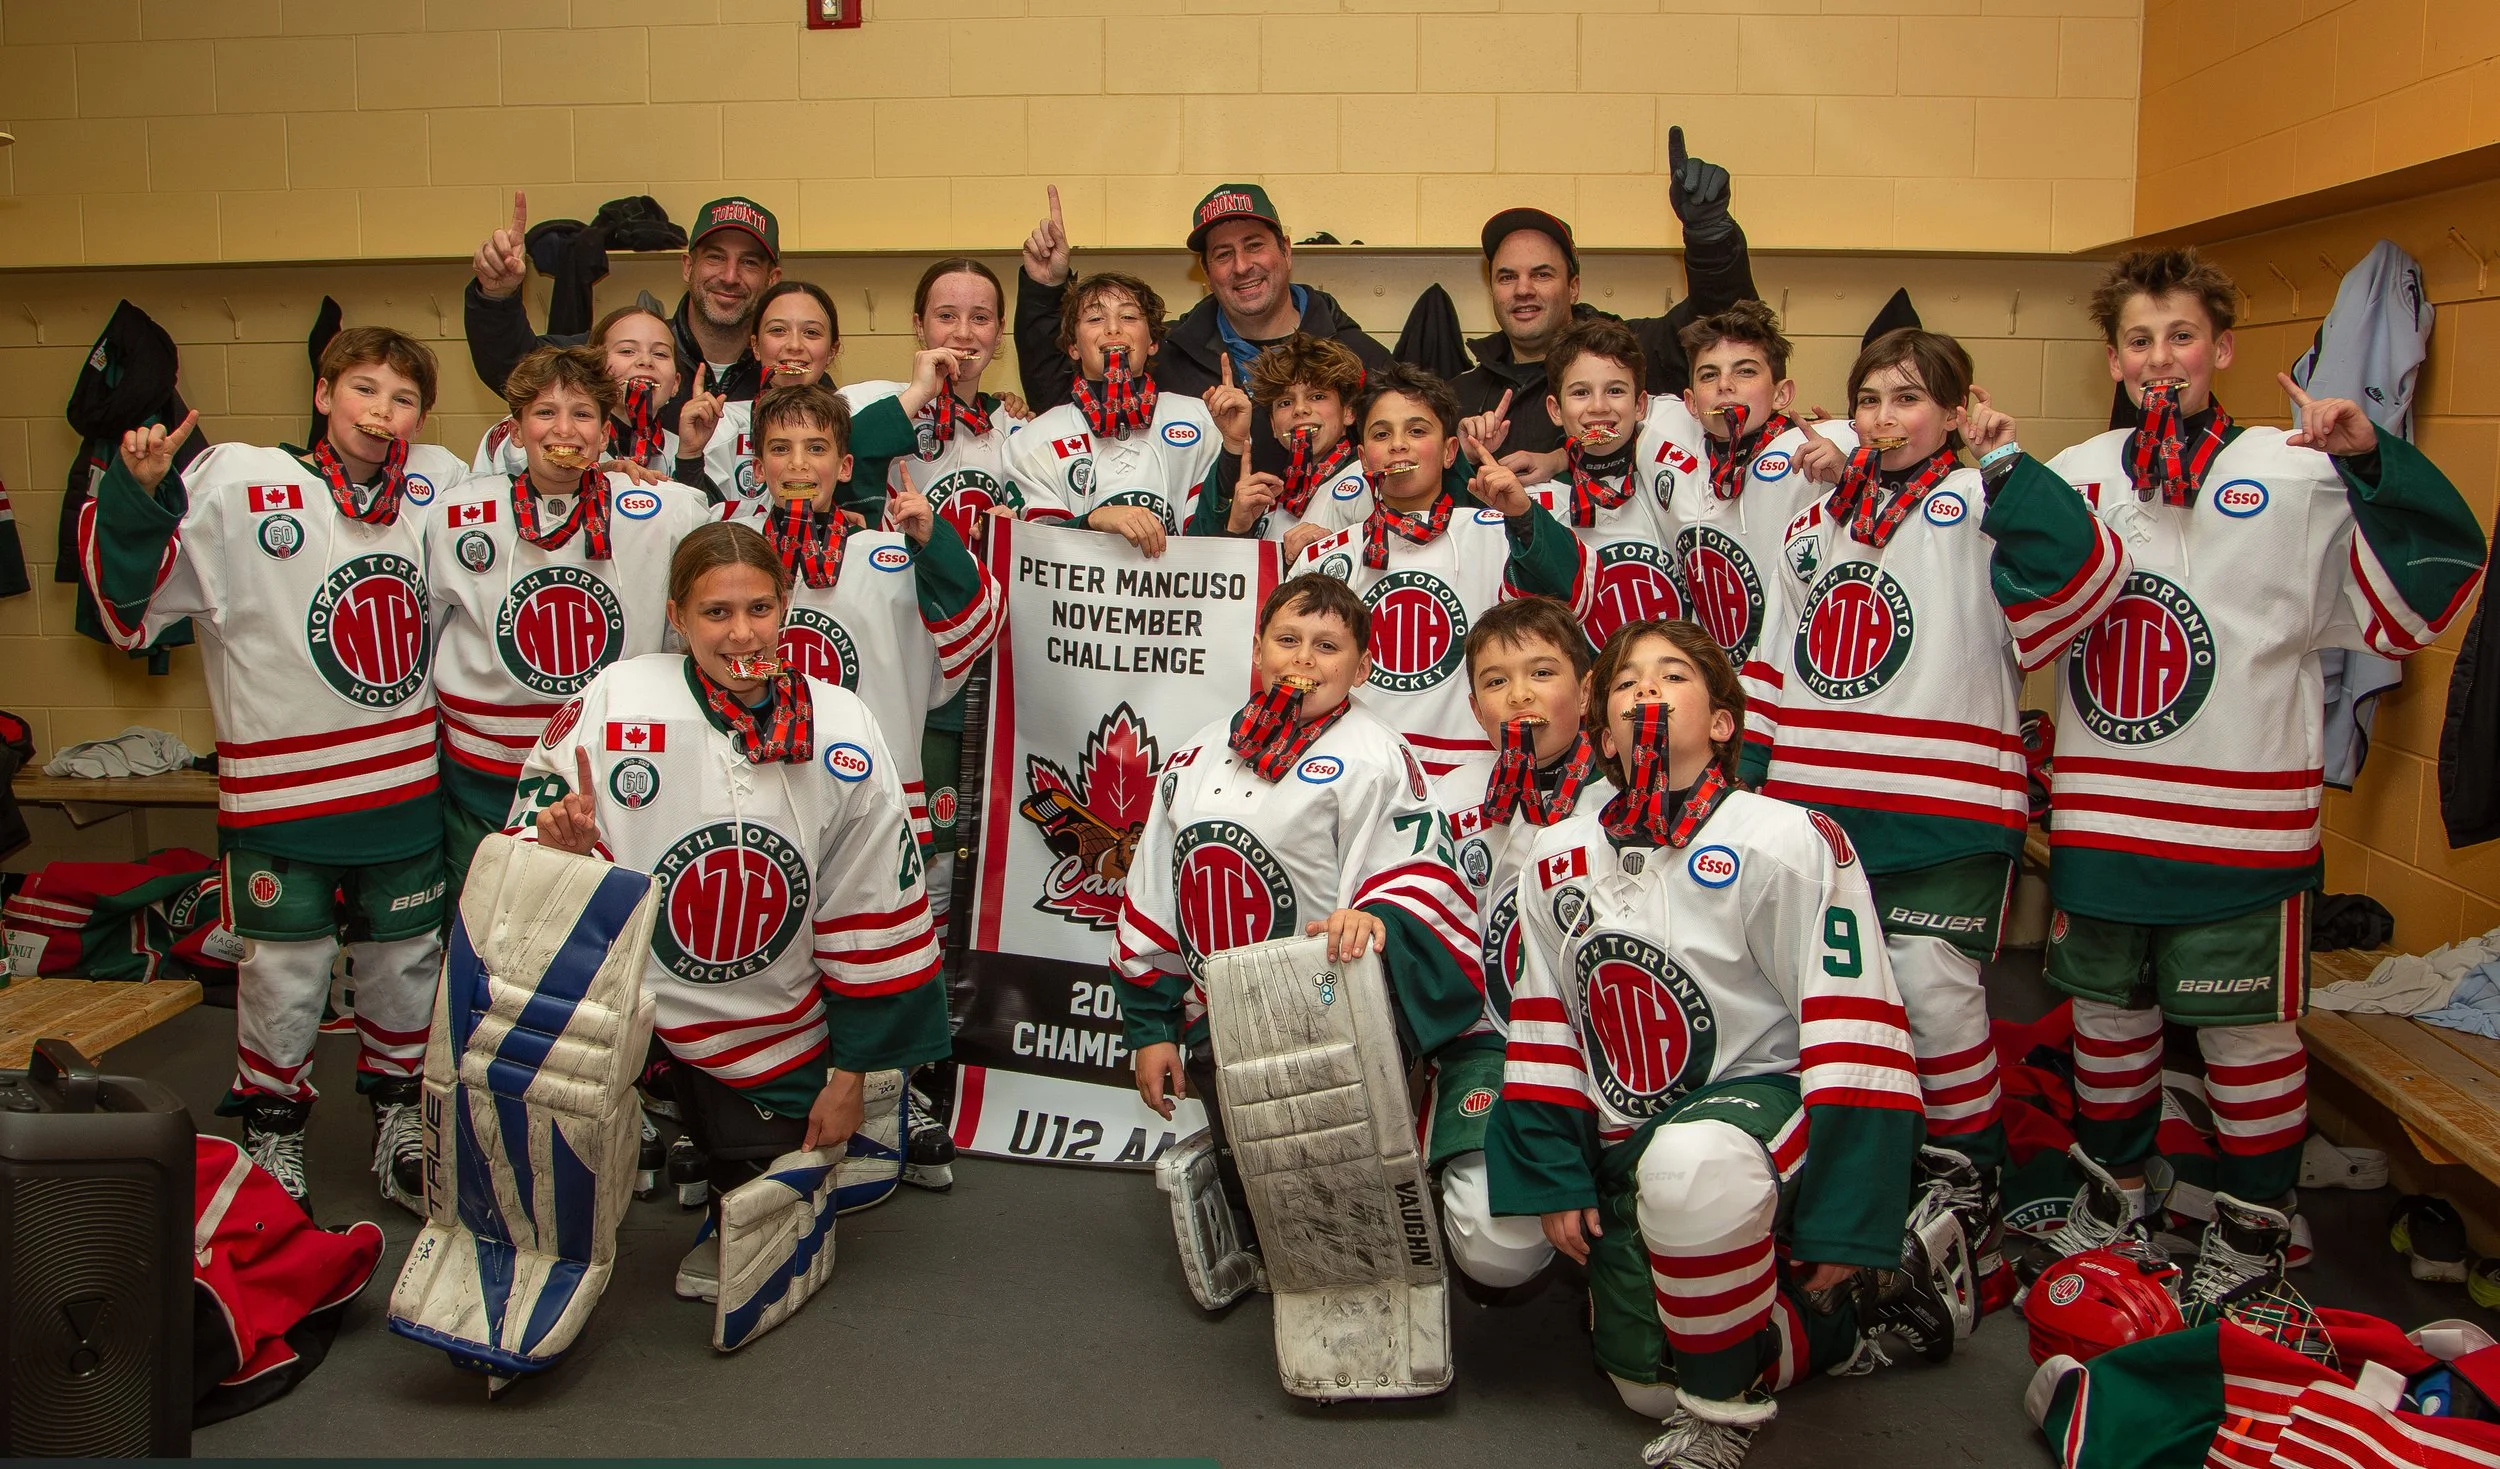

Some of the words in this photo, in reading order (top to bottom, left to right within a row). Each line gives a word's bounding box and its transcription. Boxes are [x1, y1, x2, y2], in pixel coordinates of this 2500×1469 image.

[711, 204, 767, 234] TORONTO
[1200, 193, 1254, 224] TORONTO
[1168, 428, 1197, 439] Esso
[1586, 457, 1626, 470] BAUER
[1759, 459, 1785, 472] Esso
[409, 482, 430, 496] Esso
[624, 498, 654, 509] Esso
[1337, 482, 1358, 495] Esso
[2223, 492, 2260, 505] Esso
[1480, 510, 1504, 520] Ess
[1931, 499, 1959, 518] Esso
[269, 525, 293, 546] 60
[465, 541, 487, 561] 60
[876, 552, 907, 565] Esso
[1019, 555, 1105, 594] PETER
[1115, 568, 1246, 600] MANCUSO
[311, 566, 357, 643] NORTH
[499, 575, 541, 637] NORTH
[549, 568, 622, 631] TORONTO
[1052, 600, 1203, 637] NOVEMBER
[1402, 573, 1466, 636] TORONTO
[1799, 571, 1839, 634] NORTH
[1846, 563, 1912, 638] TORONTO
[329, 574, 422, 686] NTH
[515, 585, 607, 677] NTH
[1370, 586, 1451, 676] NTH
[1808, 579, 1894, 680] NTH
[2127, 574, 2212, 667] TORONTO
[790, 610, 858, 676] TORONTO
[1047, 636, 1207, 676] CHALLENGE
[2085, 597, 2190, 721] NTH
[351, 666, 424, 705] HOCKEY
[1370, 668, 1446, 691] HOCKEY
[1808, 671, 1883, 697] HOCKEY
[2086, 709, 2180, 742] HOCKEY
[832, 750, 866, 773] Esso
[1305, 762, 1337, 776] Esso
[620, 770, 645, 791] 60
[727, 824, 808, 909] TORONTO
[1210, 822, 1293, 909] TORONTO
[1466, 850, 1485, 874] 60
[1698, 855, 1732, 877] Esso
[390, 882, 447, 913] BAUE
[669, 847, 789, 963] NTH
[1178, 844, 1273, 957] NTH
[1486, 896, 1518, 965] NORT
[1886, 906, 1987, 934] BAUER
[1822, 906, 1864, 979] 9
[673, 949, 773, 984] HOCKEY
[1577, 941, 1602, 1018] NORTH
[1606, 937, 1712, 1032] TORONTO
[2175, 976, 2272, 994] BAUER
[1070, 981, 1123, 1020] 20
[1588, 961, 1689, 1094] NTH
[1464, 1091, 1493, 1112] NTH
[1602, 1074, 1691, 1116] HOCKEY
[426, 1089, 442, 1217] TRUE
[1008, 1109, 1104, 1162] U12
[1395, 1180, 1433, 1266] VAUGHN
[398, 1241, 427, 1295] CATALYST
[2079, 1261, 2120, 1277] BAUER
